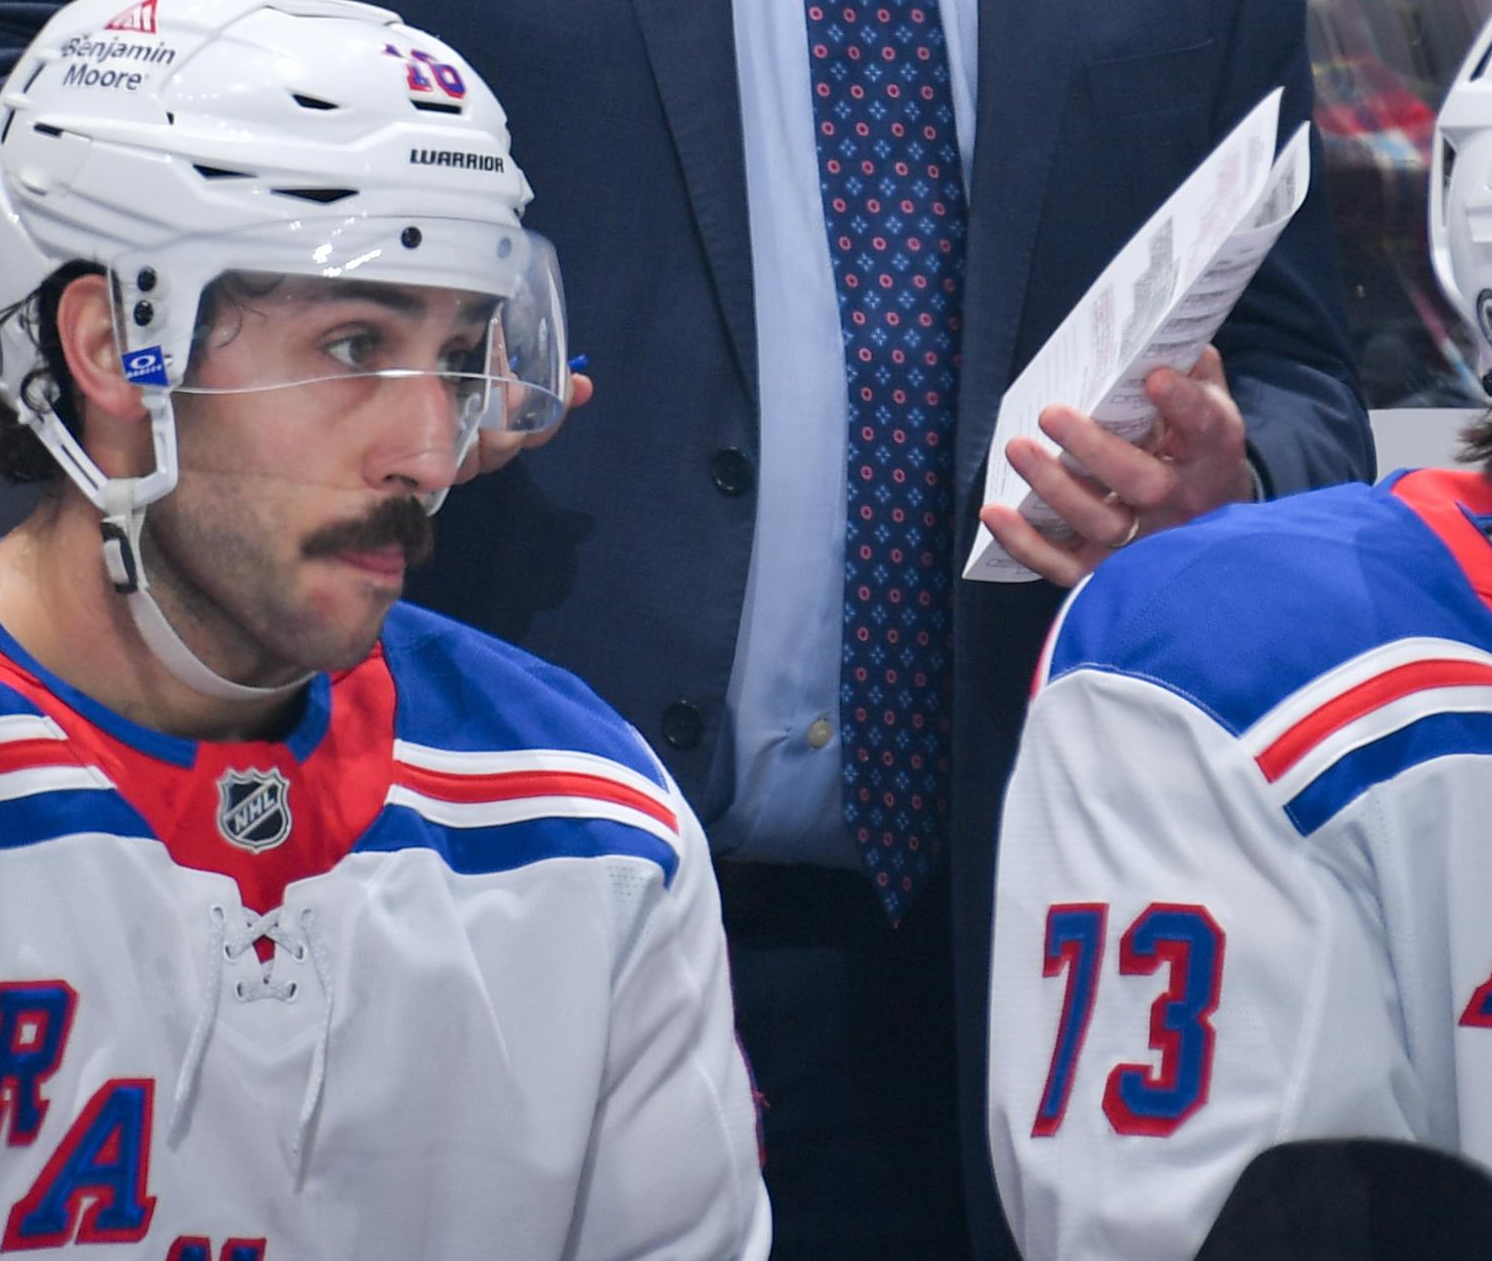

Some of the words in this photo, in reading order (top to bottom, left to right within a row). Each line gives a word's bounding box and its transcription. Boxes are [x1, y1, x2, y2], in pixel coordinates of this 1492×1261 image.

[60, 33, 176, 64] Benjamin
[62, 63, 143, 90] Moore
[409, 148, 505, 173] WARRIOR
[234, 790, 276, 833] NHL
[1030, 901, 1226, 1139] 73
